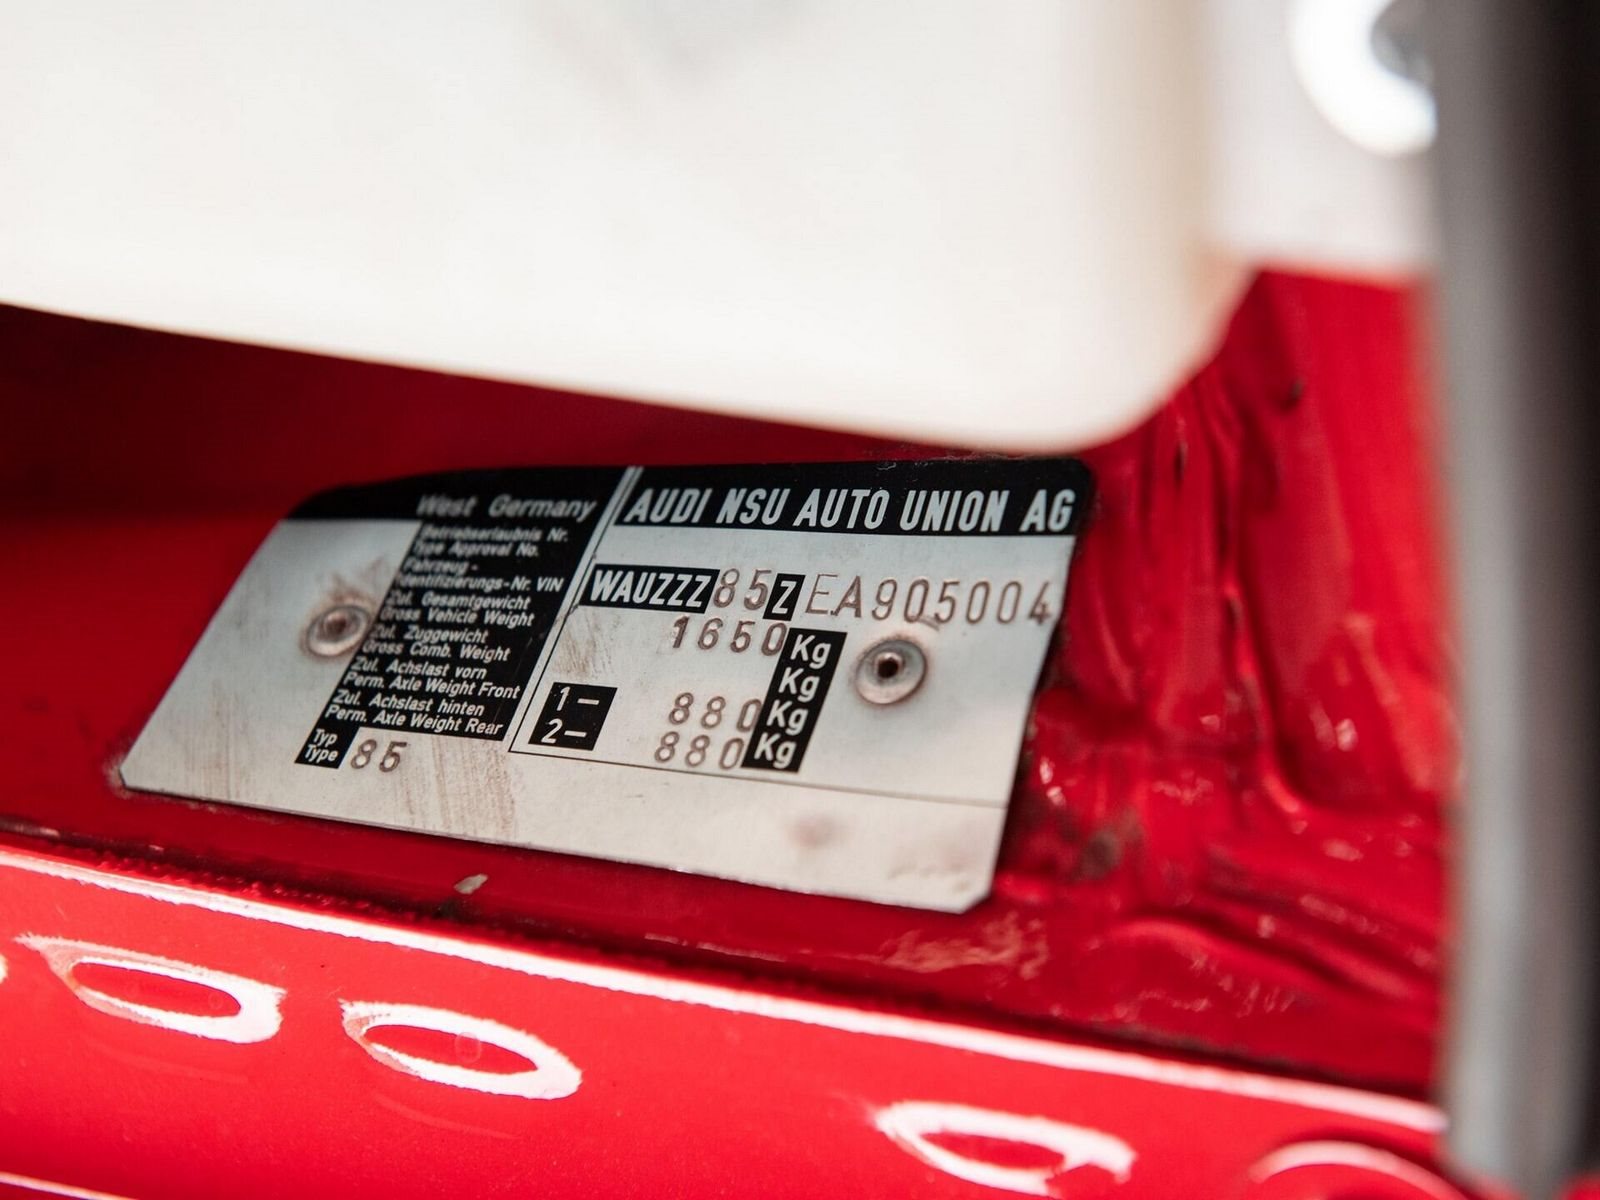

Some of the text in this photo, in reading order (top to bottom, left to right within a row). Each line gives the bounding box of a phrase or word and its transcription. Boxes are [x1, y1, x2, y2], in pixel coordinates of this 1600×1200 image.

[416, 494, 597, 522] West Germany
[623, 488, 1076, 532] AUDI NSU AUTO UNION AG
[547, 527, 569, 542] Nr.
[413, 541, 538, 558] Type Approval No.
[536, 577, 564, 592] VIN
[421, 593, 531, 611] Gesamtgewicht
[380, 607, 535, 627] Gross Vehicle Weight
[370, 623, 489, 645] Zul. Zuggewicht
[672, 615, 831, 669] 1650 Kg
[363, 640, 511, 663] Gross Comb. Weight
[351, 655, 487, 679] Zul. Achslast vorn
[343, 672, 520, 699] Perm. Axle Weight Front
[778, 667, 819, 702] Kg
[333, 689, 485, 717] Zul. Achslast hinten
[669, 692, 763, 732] 880
[766, 700, 807, 736] Kg
[325, 705, 504, 735] Perm. Axle Weight Rear
[313, 728, 338, 746] Typ
[654, 731, 744, 770] 880
[753, 733, 796, 769] Kg
[305, 739, 408, 772] Type 85
